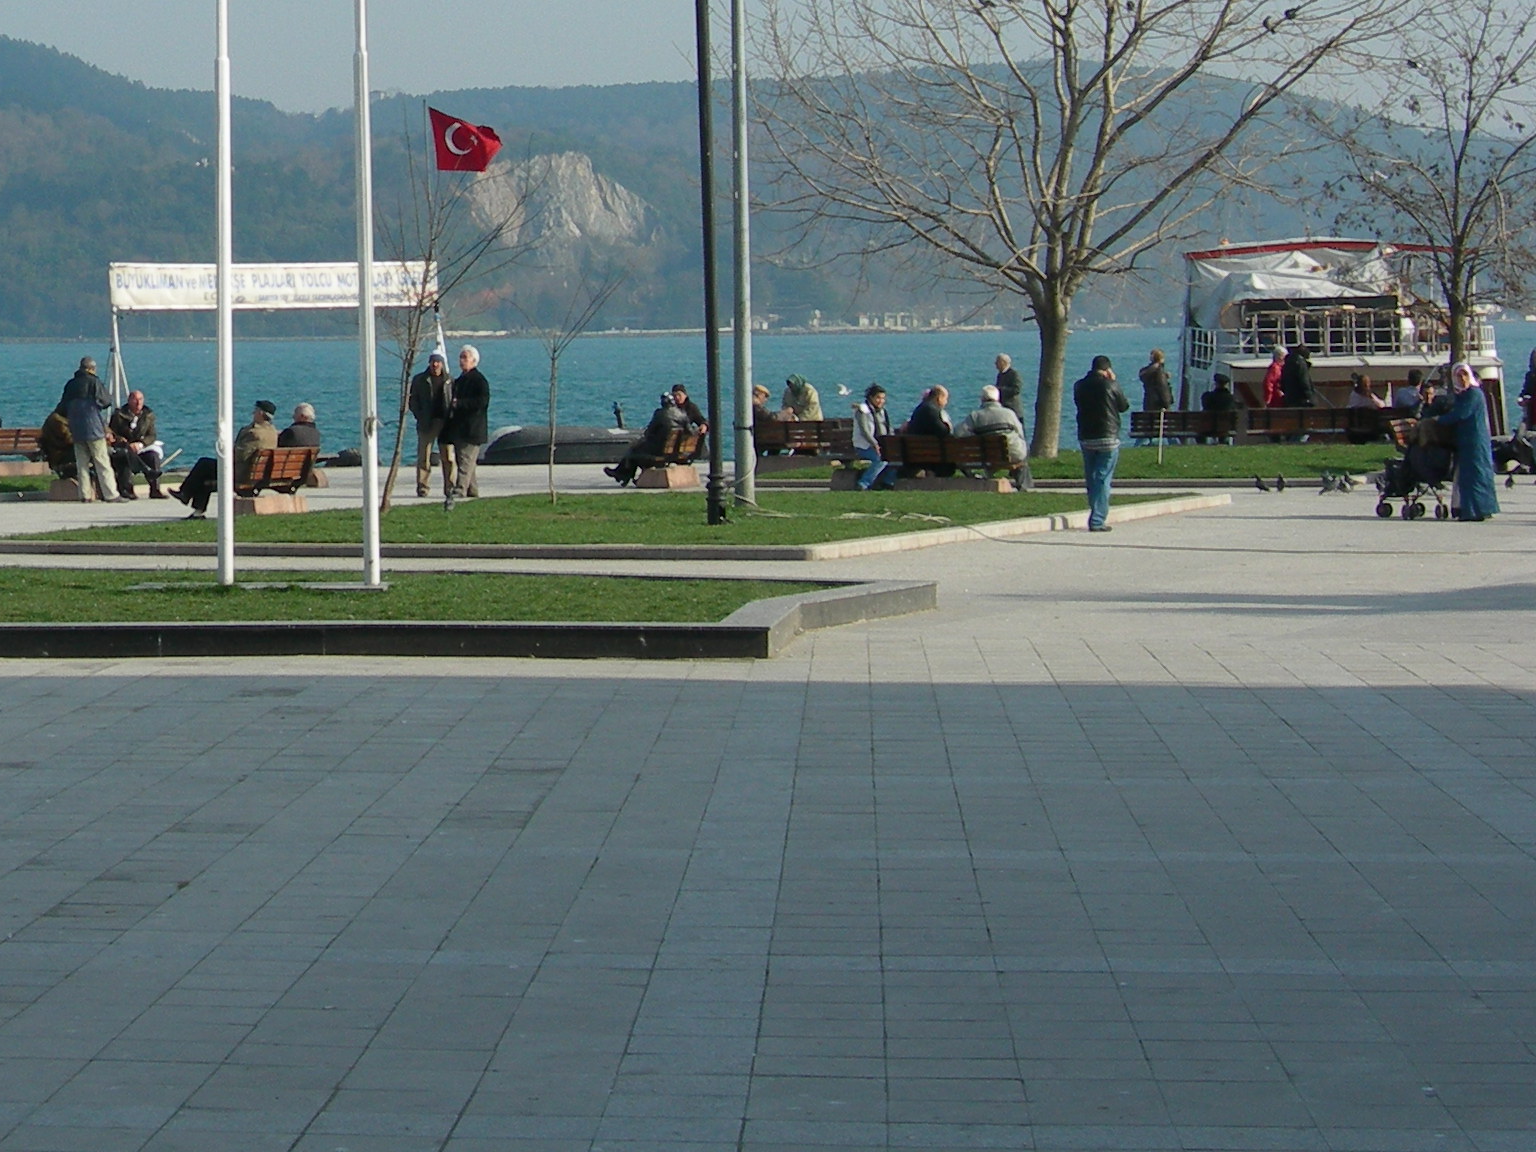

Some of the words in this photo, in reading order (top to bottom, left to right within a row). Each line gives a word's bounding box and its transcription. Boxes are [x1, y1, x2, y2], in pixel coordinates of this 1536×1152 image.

[186, 277, 198, 289] ve
[251, 272, 296, 288] PLAJLARI
[299, 272, 332, 288] YOLCU
